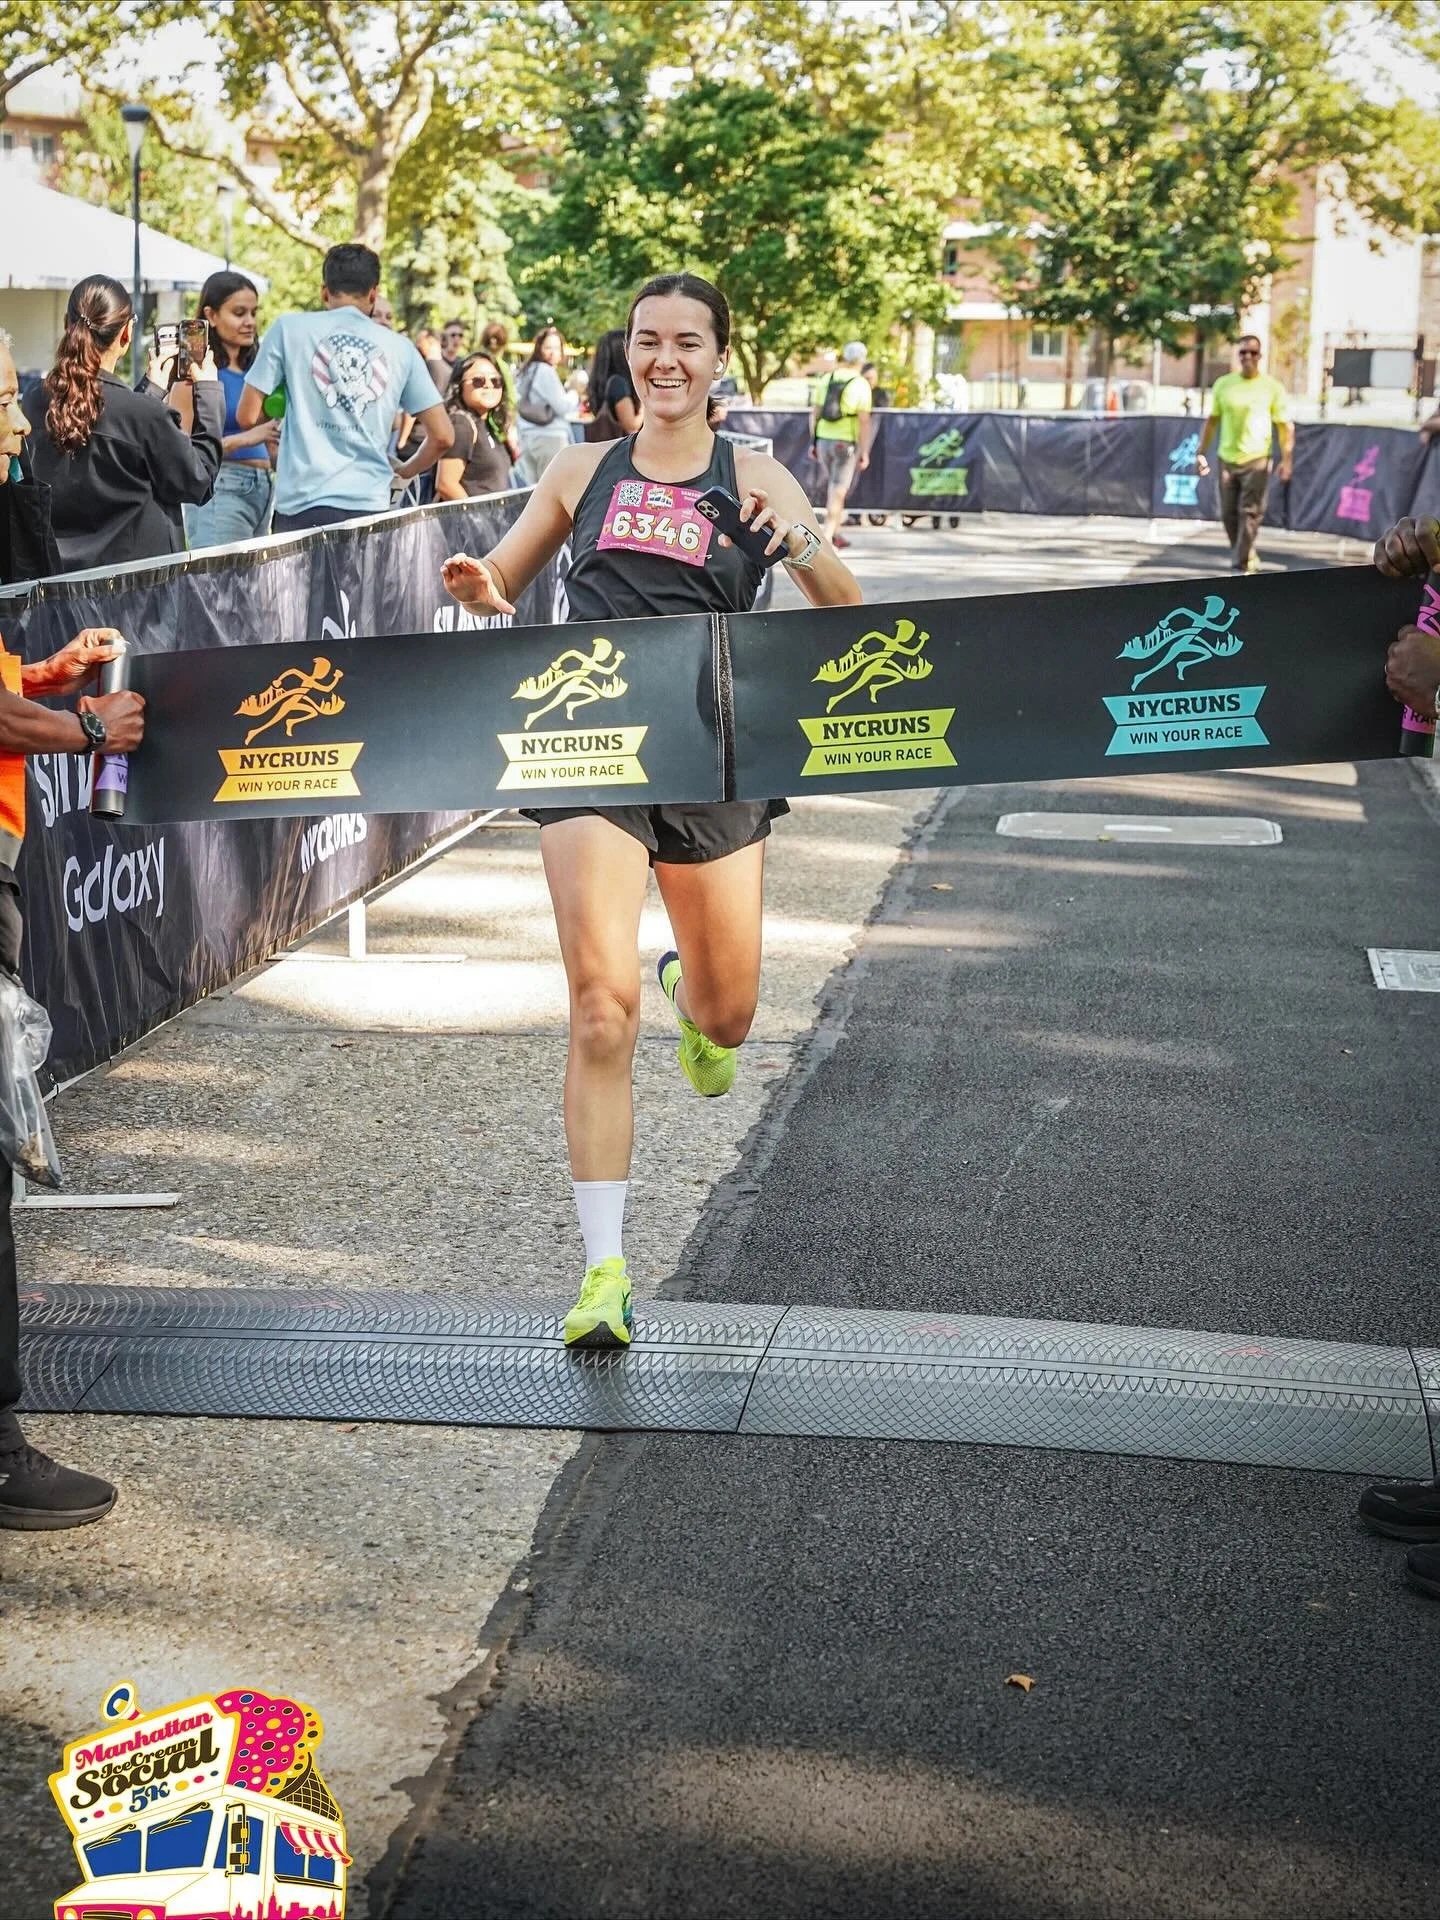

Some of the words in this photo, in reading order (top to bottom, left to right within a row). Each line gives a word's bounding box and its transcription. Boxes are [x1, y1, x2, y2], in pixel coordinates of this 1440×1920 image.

[612, 511, 700, 551] 6346
[1128, 694, 1241, 718] NYCRUNS
[823, 716, 931, 740] NYCRUNS
[1130, 731, 1158, 745] WIN
[1162, 729, 1200, 742] YOUR
[1204, 726, 1243, 740] RACE
[521, 734, 623, 755] NYCRUNS
[239, 750, 339, 769] NYCRUNS
[824, 753, 851, 765] WIN
[855, 750, 892, 763] YOUR
[896, 747, 932, 760] RACE
[521, 768, 547, 779] WIN
[551, 766, 585, 778] YOUR
[589, 764, 624, 776] RACE
[238, 782, 262, 792] WIN
[267, 780, 300, 791] YOUR
[304, 778, 338, 790] RACE
[301, 812, 367, 874] NYCRUNS
[63, 837, 165, 932] Galaxy
